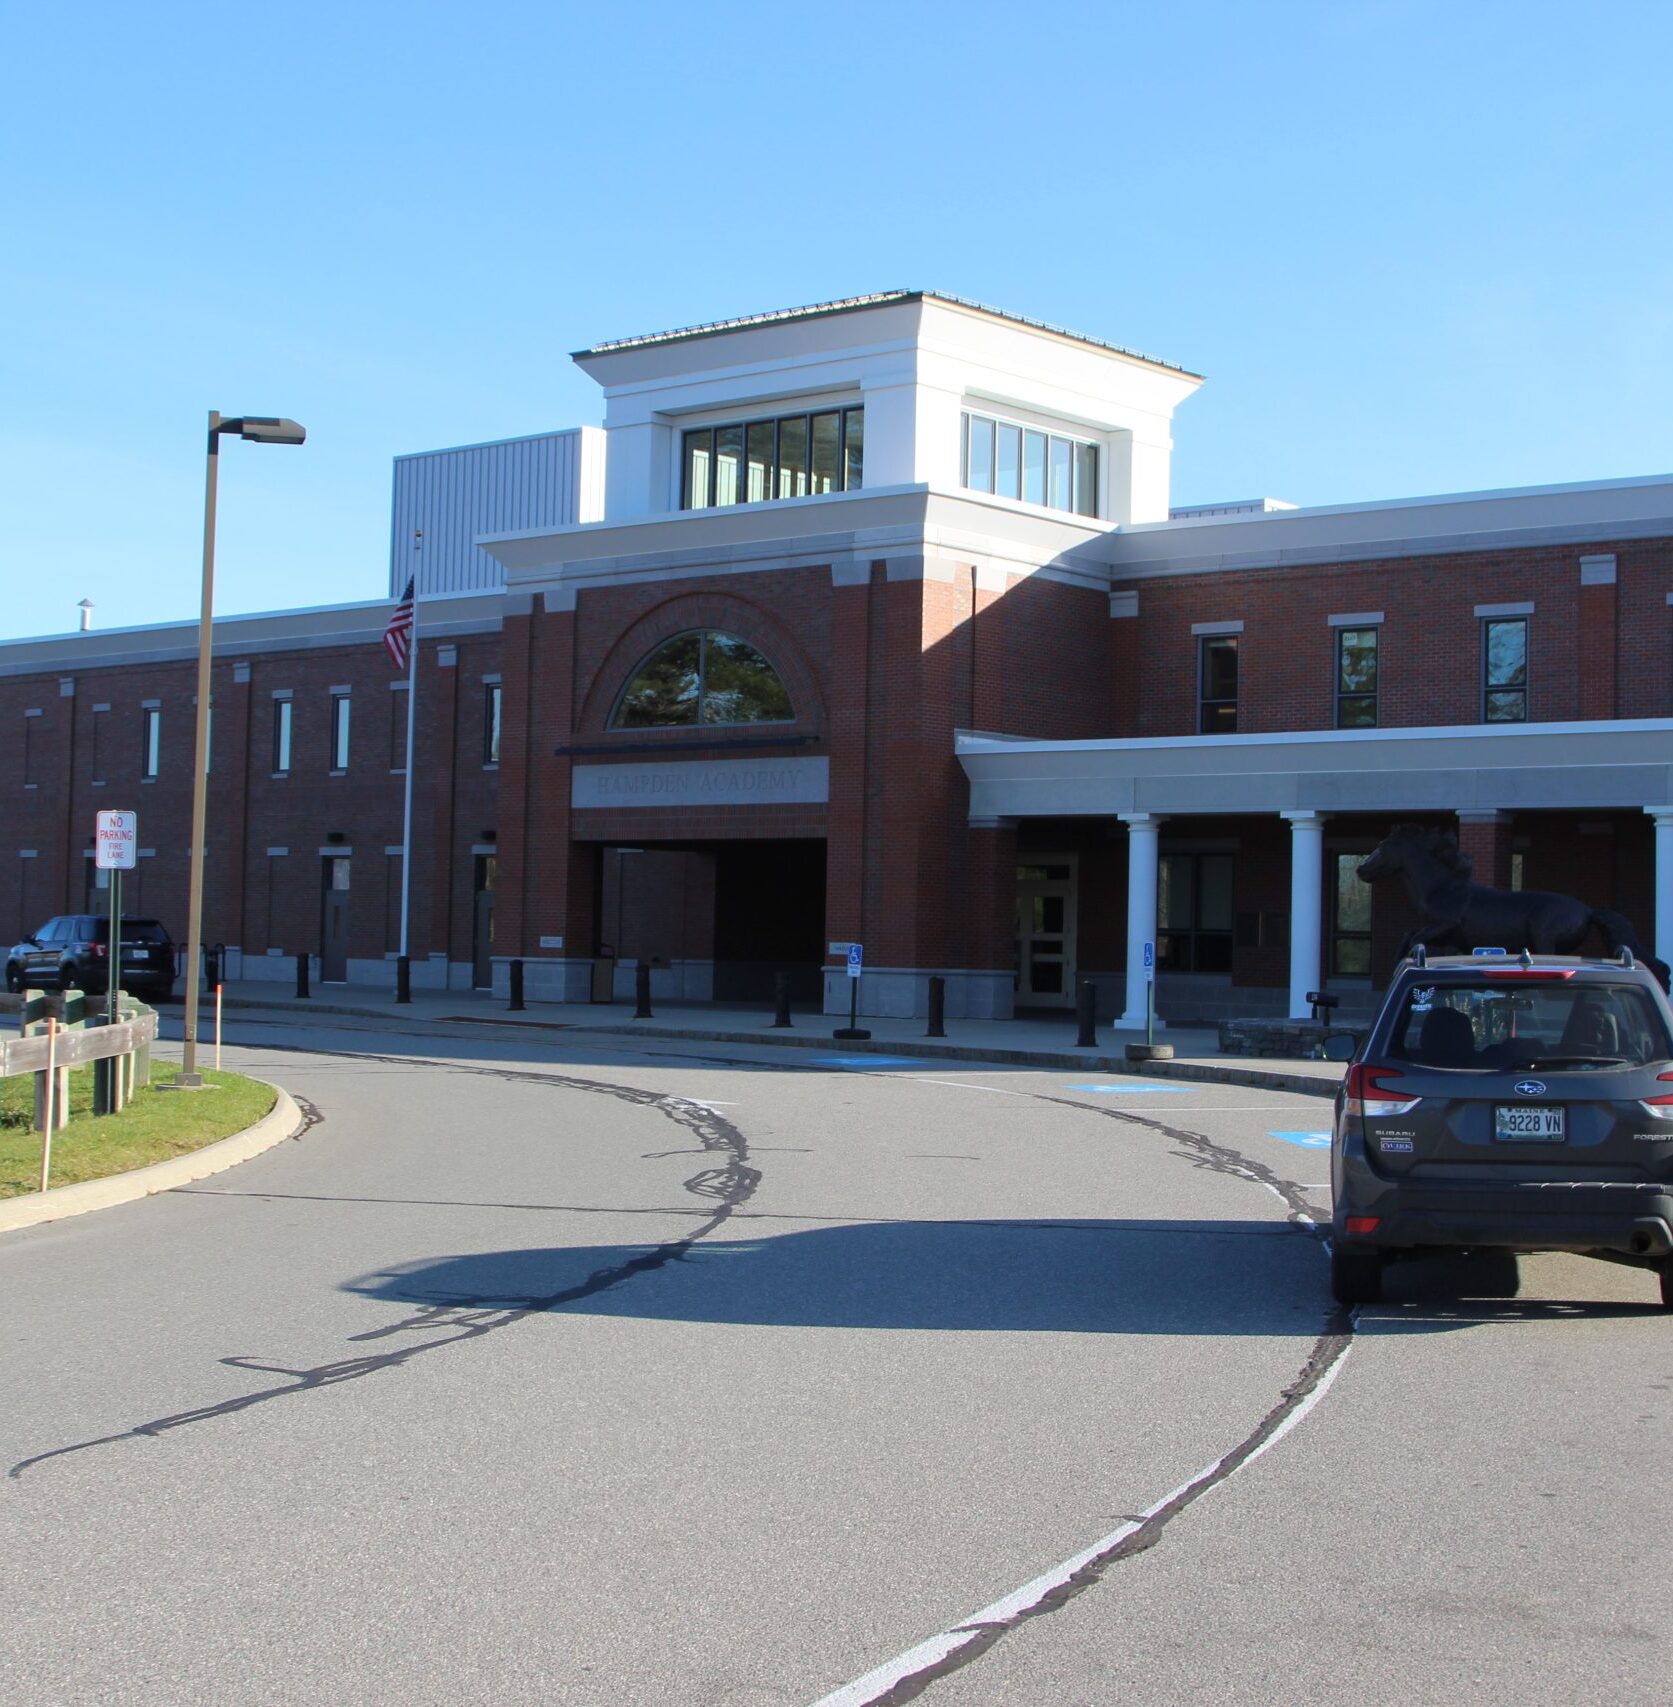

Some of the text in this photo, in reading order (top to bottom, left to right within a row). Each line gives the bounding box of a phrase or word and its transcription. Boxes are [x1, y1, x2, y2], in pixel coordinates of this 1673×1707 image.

[597, 770, 802, 794] HAMPDEN ACADEMY
[110, 817, 123, 828] NO
[100, 830, 133, 841] PARKING
[108, 842, 123, 850] FIRE
[107, 851, 125, 859] LANE
[1508, 1115, 1561, 1132] 9228 VN
